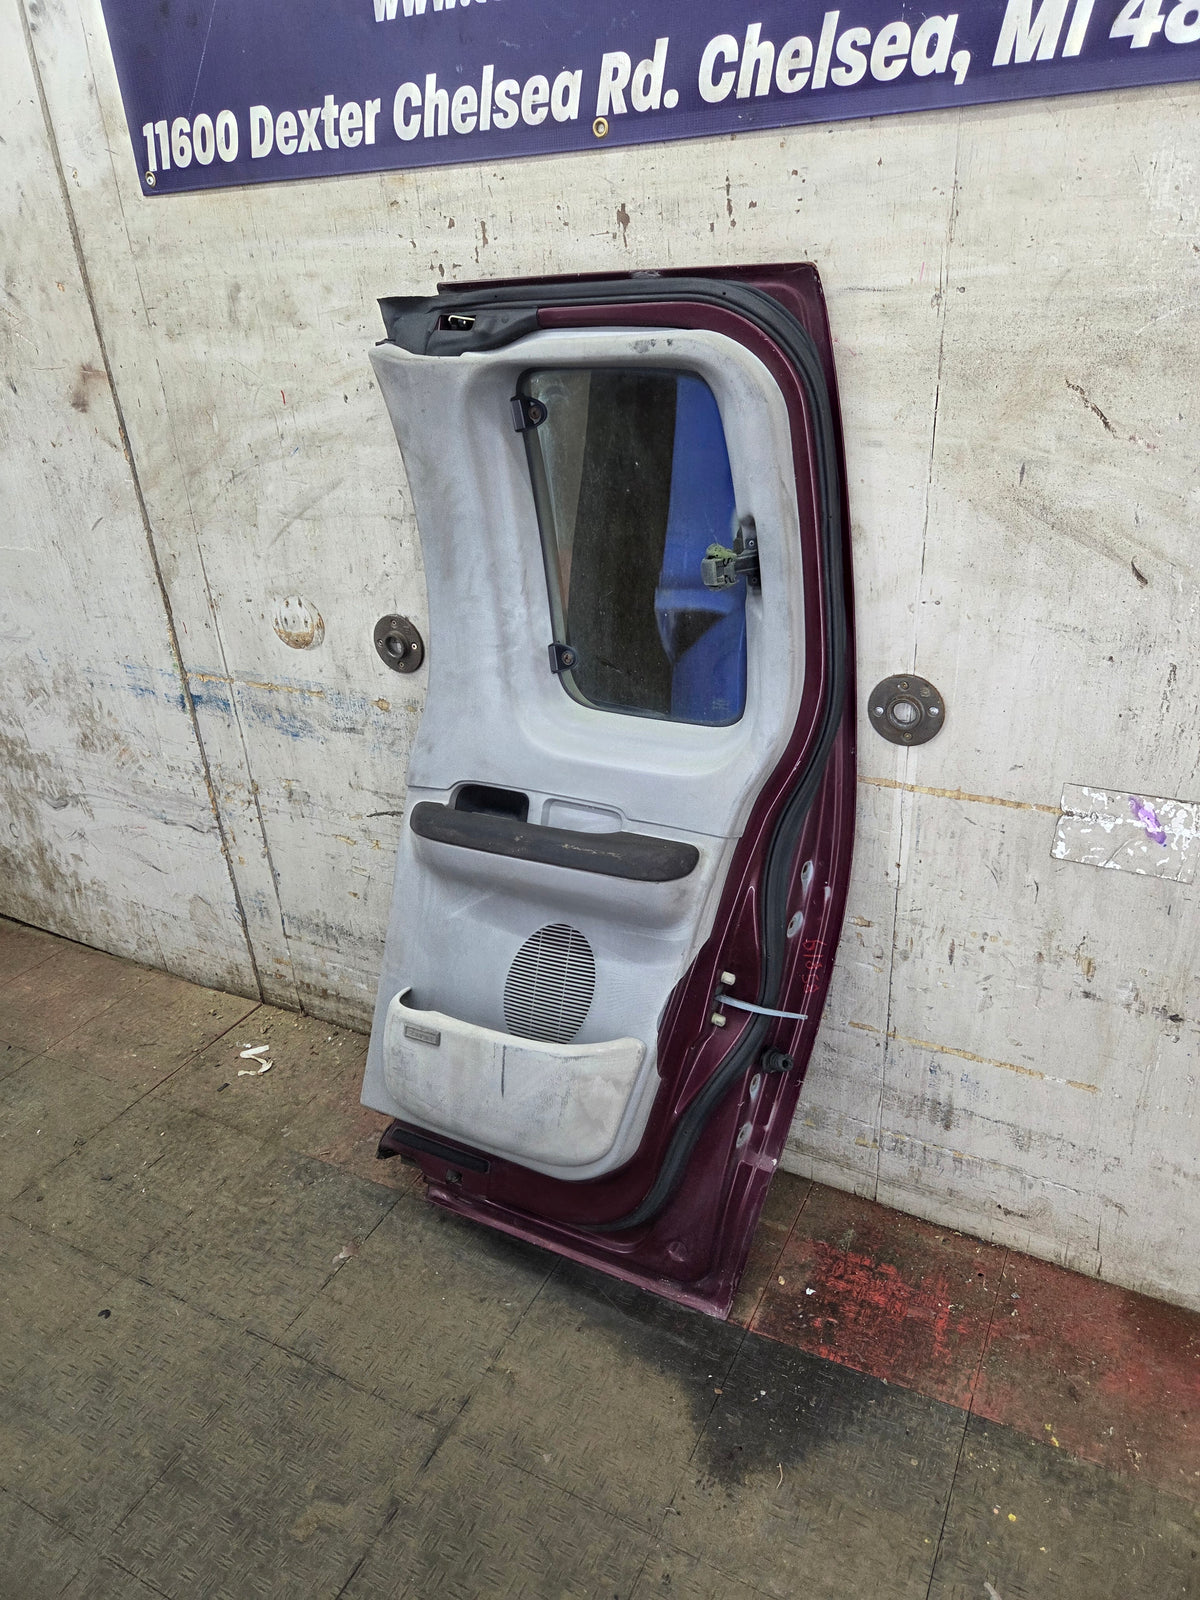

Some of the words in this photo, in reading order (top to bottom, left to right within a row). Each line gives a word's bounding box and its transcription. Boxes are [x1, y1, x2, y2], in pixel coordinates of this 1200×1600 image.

[143, 109, 239, 171] 11600
[249, 94, 382, 159] Dexter
[393, 64, 584, 141] Chelsea
[595, 37, 680, 117] Rd.
[698, 10, 971, 104] Chelsea,
[992, 0, 1096, 67] MI
